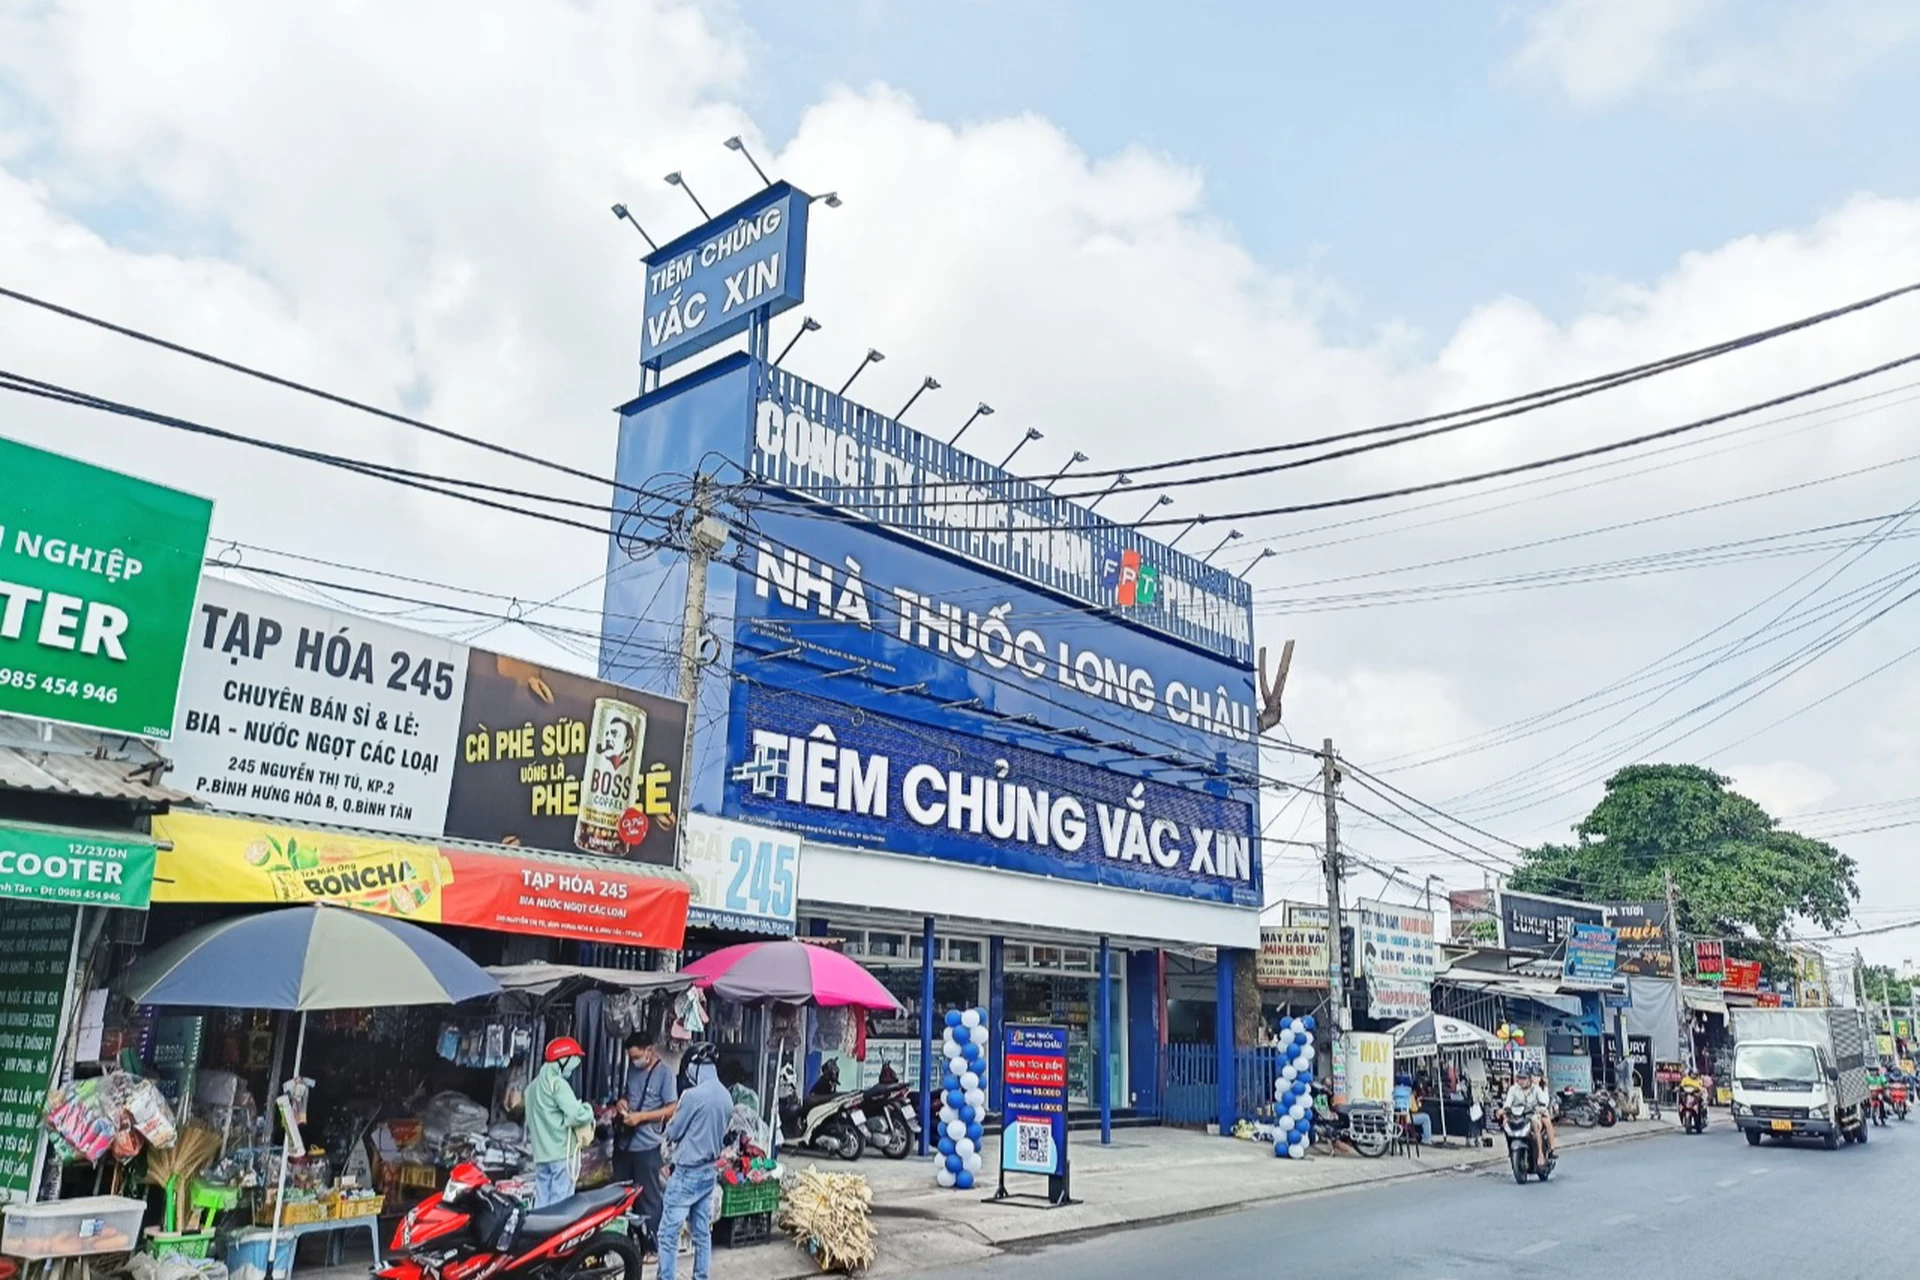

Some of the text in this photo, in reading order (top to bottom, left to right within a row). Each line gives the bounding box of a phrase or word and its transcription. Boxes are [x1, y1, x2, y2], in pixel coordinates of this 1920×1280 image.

[651, 207, 782, 296] TIÊM CHỦNG
[648, 252, 780, 348] VẮC XIN
[756, 400, 859, 487] CÔNG
[1102, 553, 1155, 600] FPT
[14, 530, 144, 583] NGHIỆP
[201, 603, 455, 701] TẠP HÓA 245
[755, 539, 872, 630] NHÀ
[894, 586, 1046, 679] THUỐC
[1058, 641, 1156, 715] LONG
[1164, 681, 1252, 743] CHÂU
[41, 676, 79, 698] 454
[85, 684, 118, 704] 946
[223, 679, 420, 737] CHUYÊN BÁN SỈ & LẺ:
[185, 710, 221, 736] BIA
[244, 719, 299, 749] NƯỚC
[305, 731, 356, 761] NGỌT
[360, 739, 396, 766] CÁC
[401, 748, 438, 776] LOẠI
[465, 717, 586, 763] CÀ PHÊ SỮA
[228, 756, 256, 773] 245
[260, 760, 315, 784] NGUYỄN
[319, 769, 340, 788] THỊ
[367, 779, 395, 796] KP.2
[520, 757, 566, 783] UỐNG LÀ
[590, 767, 632, 801] BOSS
[196, 776, 246, 797] P.BÌNH
[251, 783, 290, 804] HƯNG
[295, 789, 321, 808] HÒA
[342, 796, 386, 818] Q.BÌNH
[390, 804, 413, 821] TÂN
[903, 758, 1087, 852] CHỦNG
[1096, 780, 1180, 868] VẮC
[1189, 825, 1251, 881] XIN
[68, 843, 128, 860] 12/23/DN
[58, 887, 82, 898] 0985
[84, 890, 101, 900] 454
[102, 891, 121, 901] 946
[304, 859, 417, 896] BONCHA
[521, 868, 628, 899] TẠP HÓA 245
[725, 836, 796, 917] 245
[519, 895, 535, 906] BIA
[563, 901, 587, 914] NGỌT
[588, 903, 606, 916] CÁC
[606, 907, 627, 920] LOẠI
[1513, 909, 1555, 943] Luxury
[1620, 904, 1644, 917] TƯƠI
[1263, 944, 1319, 956] MINH HUY
[1359, 1037, 1390, 1064] MÁY
[1361, 1068, 1388, 1099] CẮT
[558, 1226, 596, 1253] 150
